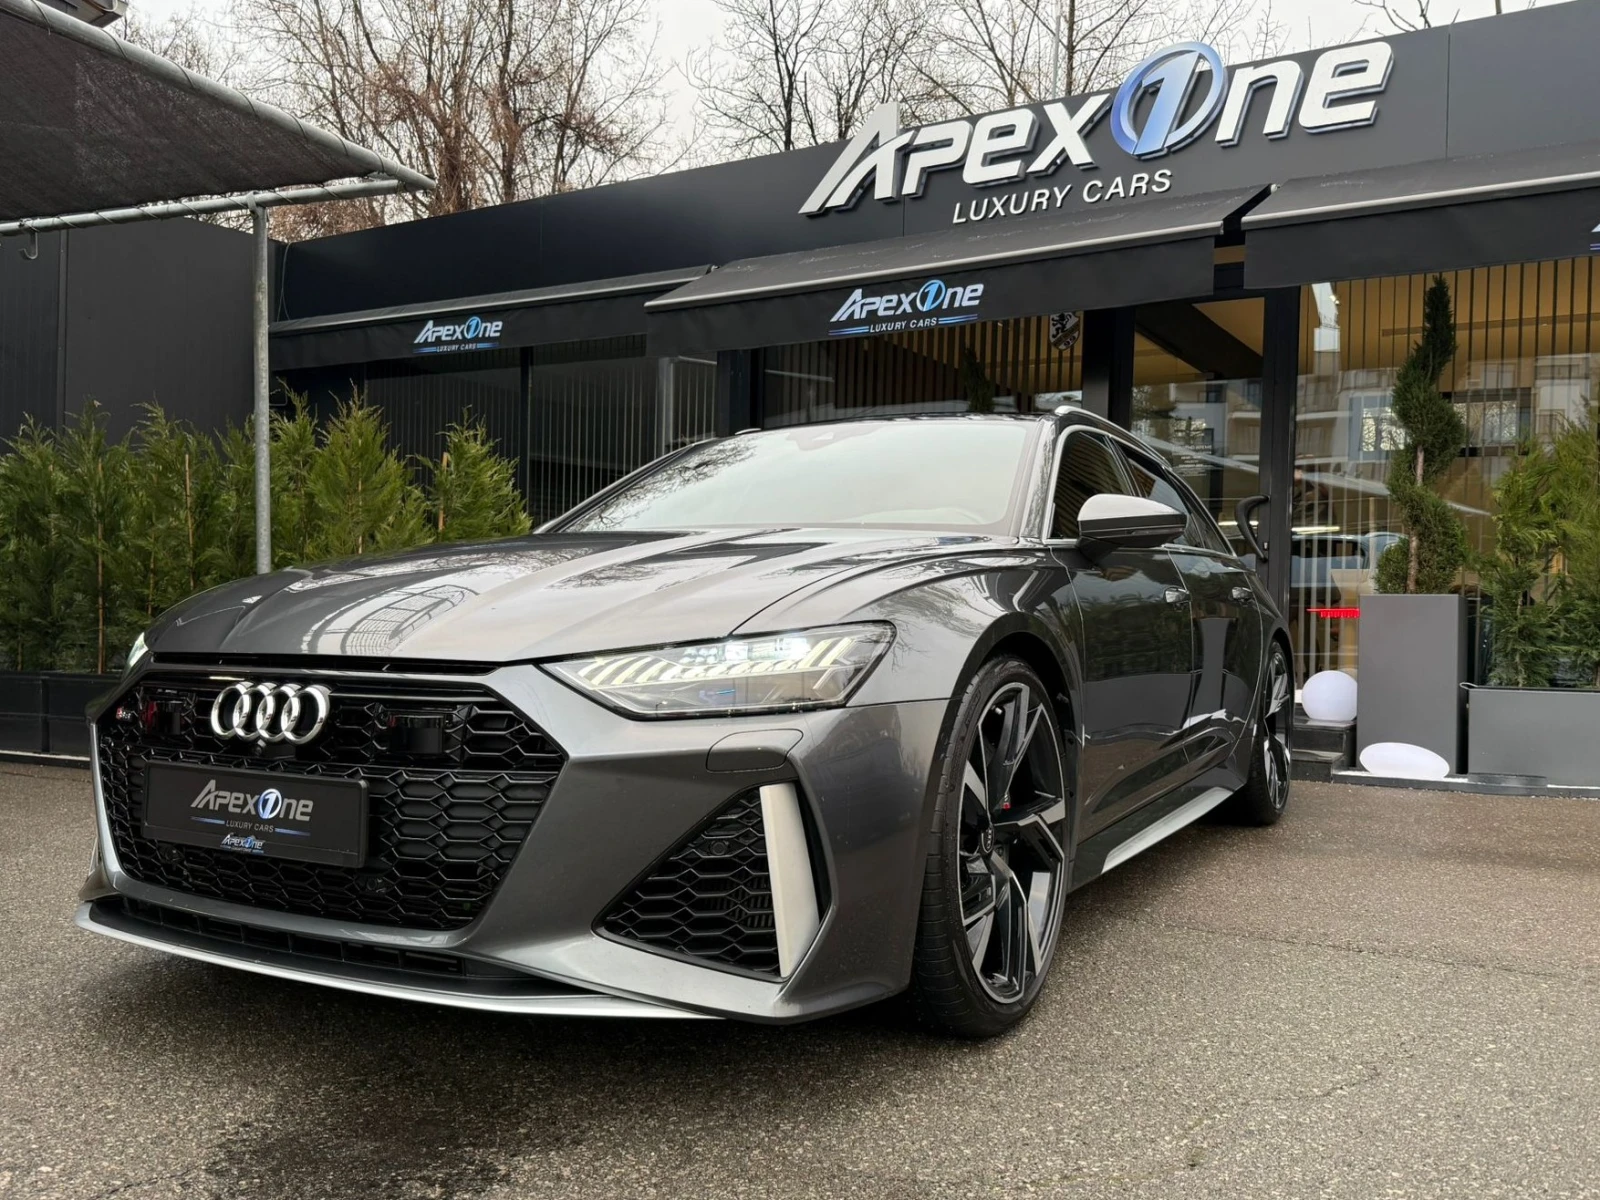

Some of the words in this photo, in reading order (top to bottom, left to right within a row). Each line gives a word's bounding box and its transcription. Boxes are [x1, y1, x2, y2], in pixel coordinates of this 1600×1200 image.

[952, 185, 1072, 224] LUXURY
[1082, 169, 1173, 203] CARS
[870, 321, 906, 333] LUXURY
[909, 317, 938, 328] CARS
[437, 344, 459, 352] LUXURY
[225, 820, 252, 830] LUXURY
[254, 824, 274, 833] CARS
